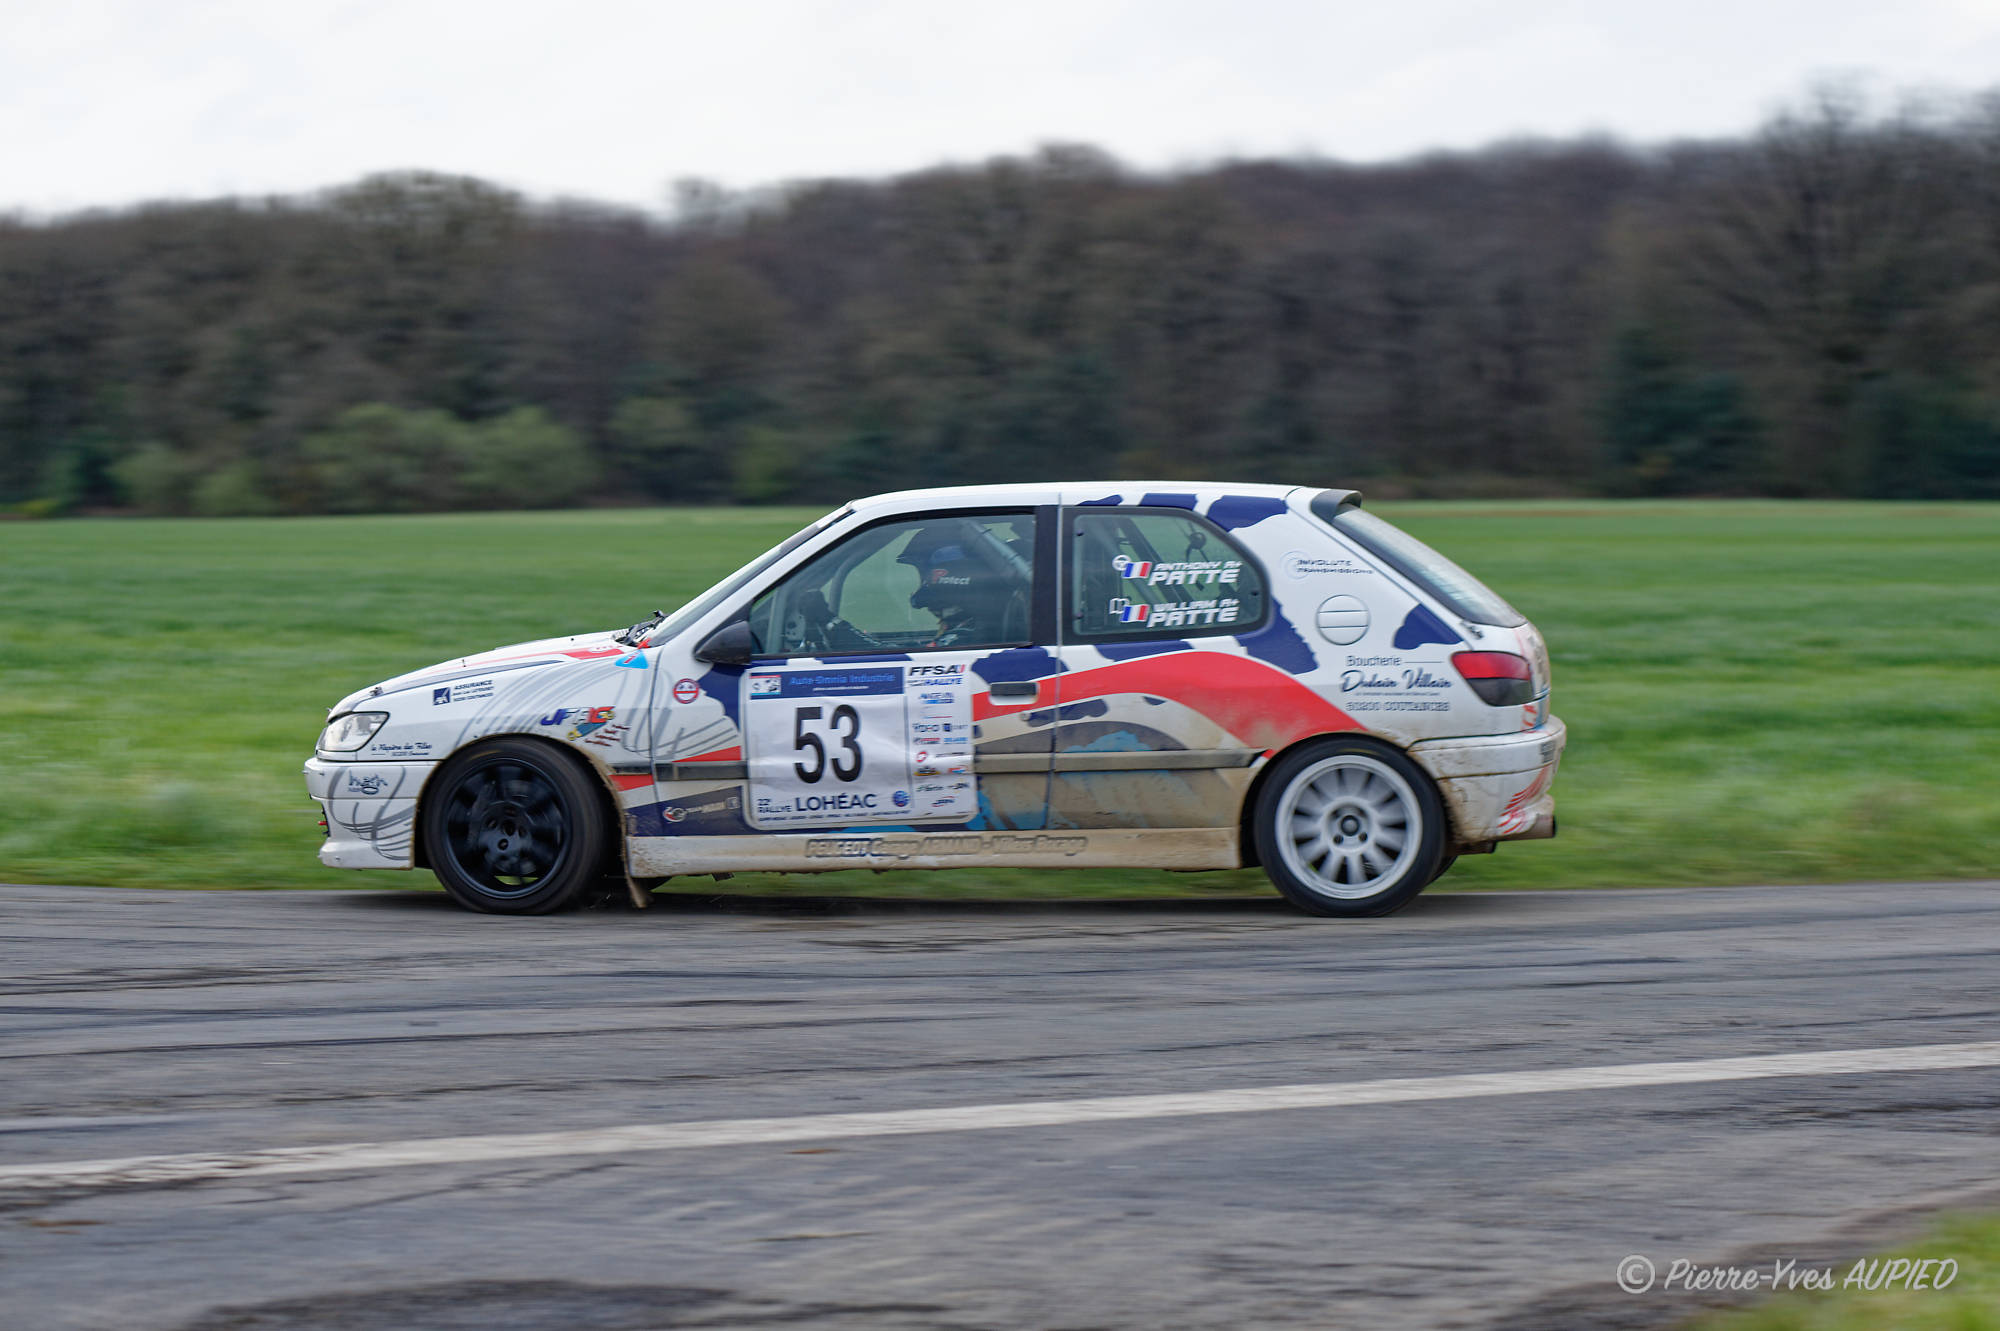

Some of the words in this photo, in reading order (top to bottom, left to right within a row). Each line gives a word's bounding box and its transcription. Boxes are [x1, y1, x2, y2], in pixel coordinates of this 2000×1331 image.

[1154, 561, 1221, 571] ANTHONY
[1147, 568, 1240, 586] PATTE
[1153, 599, 1217, 612] WILLIAM
[1146, 606, 1239, 628] PATTE
[1346, 655, 1402, 667] Boucherie
[909, 664, 965, 676] FFSA
[454, 680, 493, 690] ASSURANCE
[794, 704, 863, 784] 53
[795, 792, 877, 812] LOHÉAC
[757, 805, 792, 814] RALLYE
[806, 839, 871, 857] PEUGEOT
